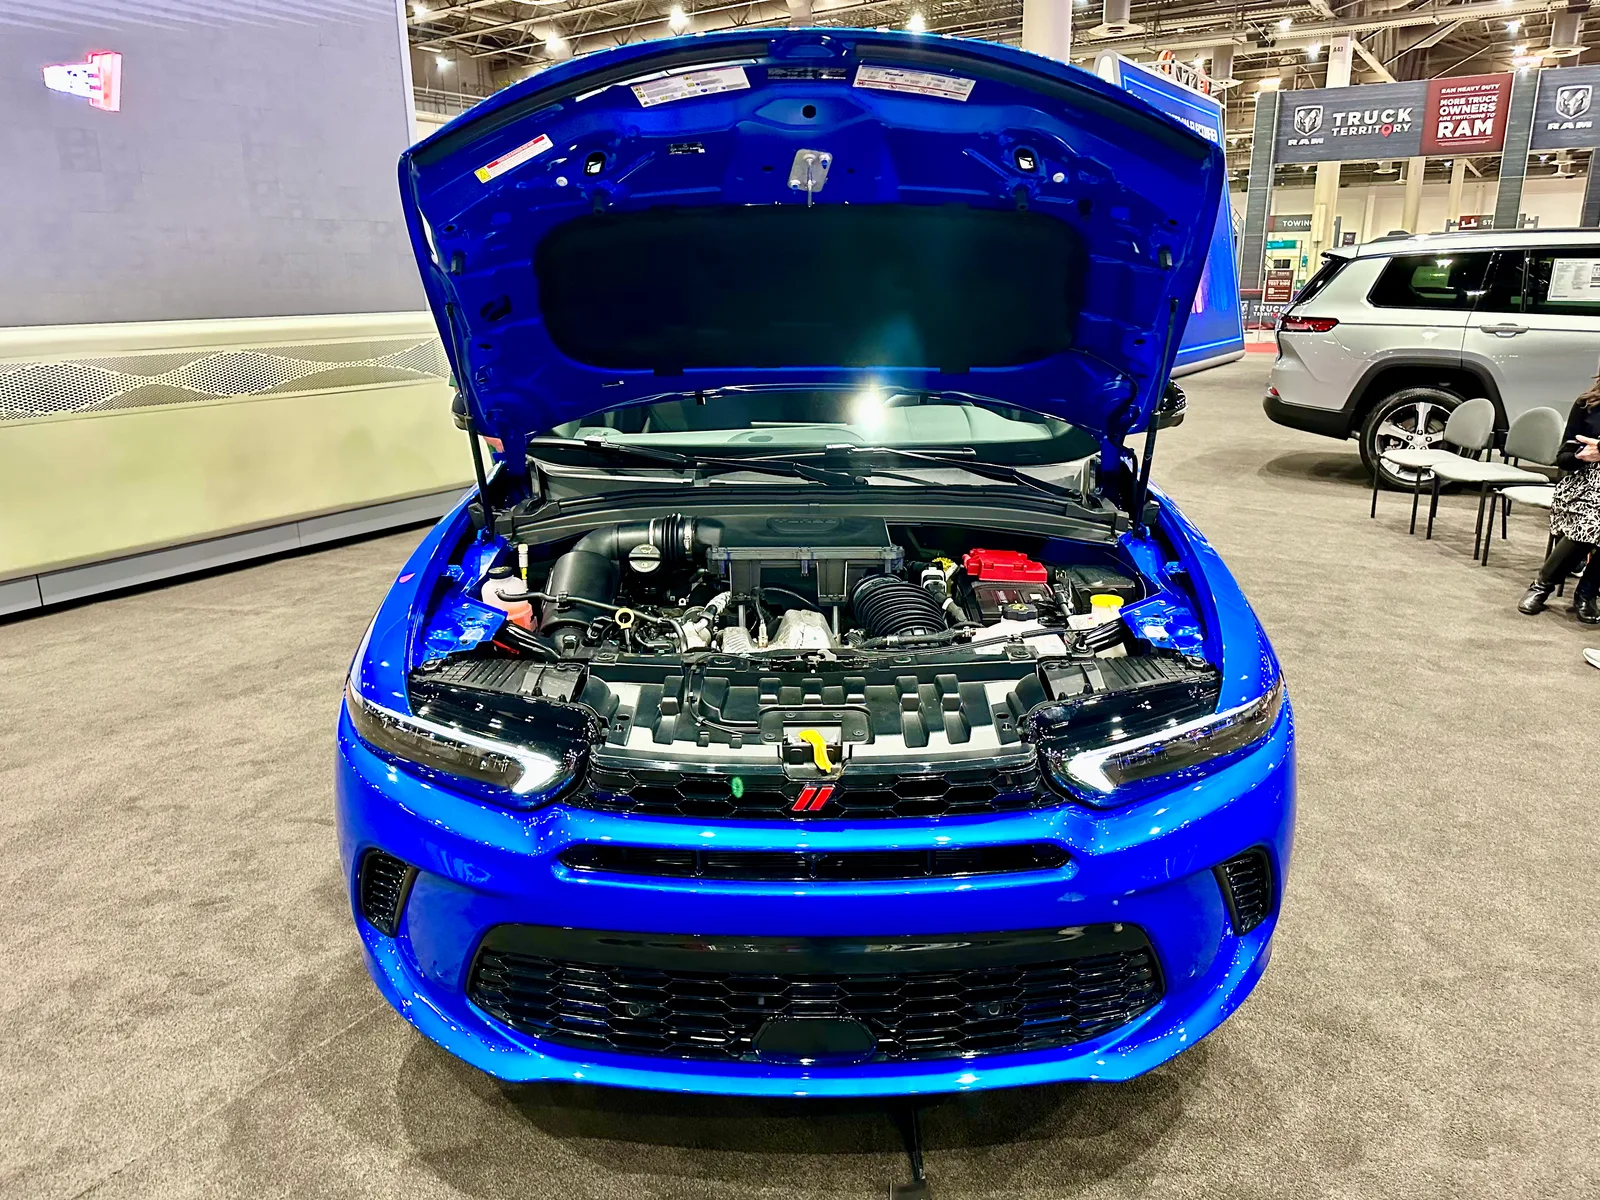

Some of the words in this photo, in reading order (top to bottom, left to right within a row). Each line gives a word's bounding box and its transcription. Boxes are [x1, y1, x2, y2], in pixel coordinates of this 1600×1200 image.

[1440, 98, 1466, 106] MORE
[1468, 95, 1498, 104] TRUCK
[1440, 103, 1496, 115] OWNERS
[1332, 108, 1413, 126] TRUCK
[1332, 123, 1412, 137] TERRITORY
[1437, 118, 1494, 138] RAM
[1548, 121, 1592, 130] RAM
[1288, 138, 1324, 146] RAM
